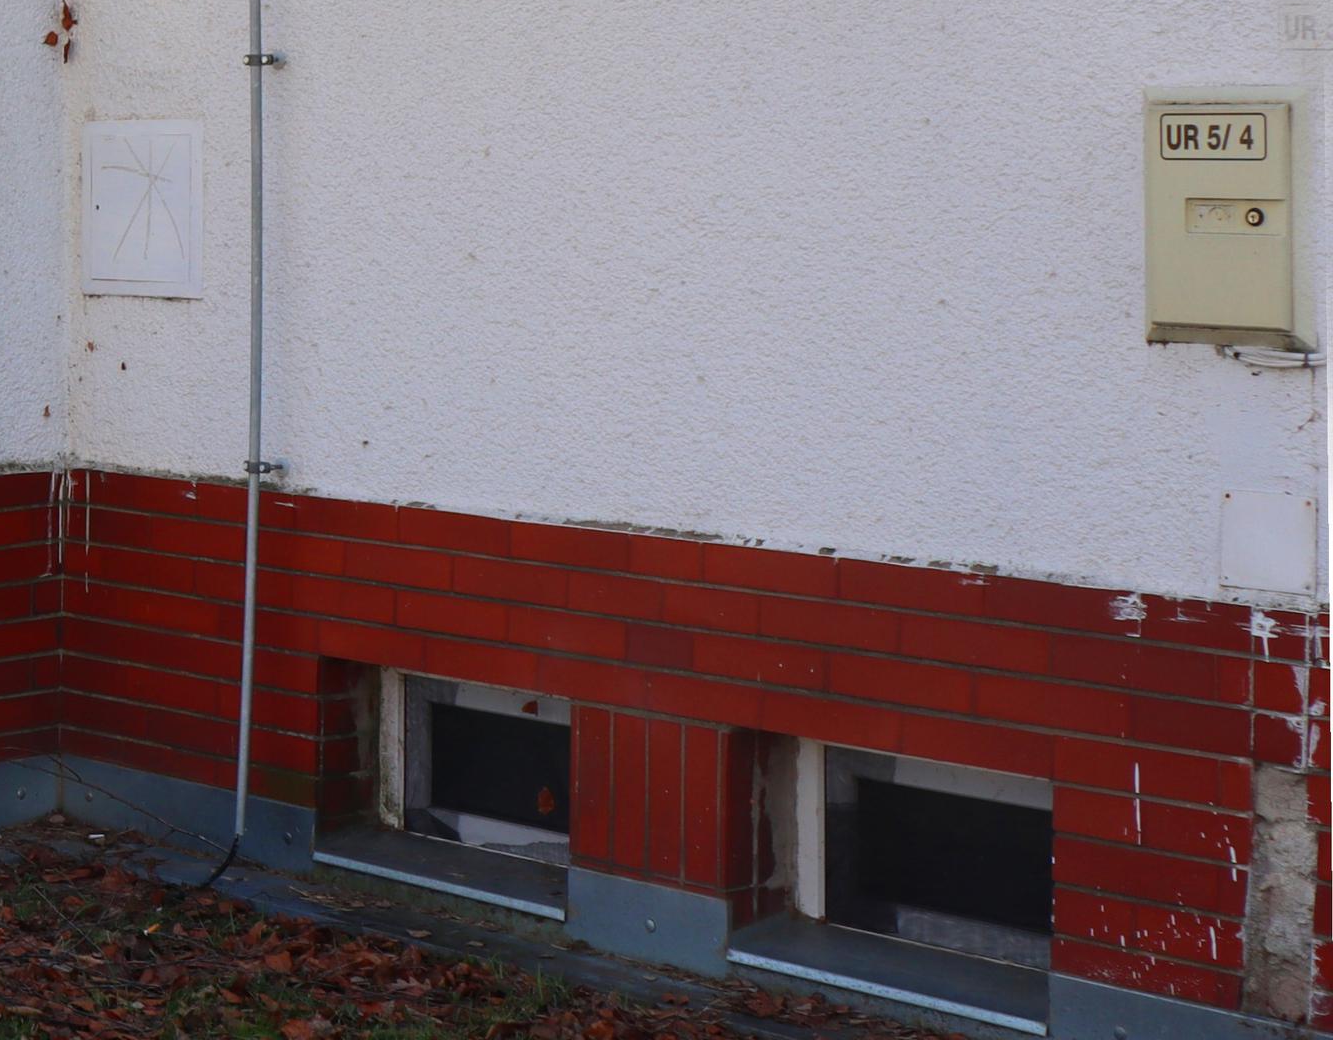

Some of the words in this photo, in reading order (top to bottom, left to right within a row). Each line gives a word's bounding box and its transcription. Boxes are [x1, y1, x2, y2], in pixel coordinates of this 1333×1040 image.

[1166, 124, 1199, 150] UR
[1207, 123, 1232, 151] 5/
[1239, 124, 1254, 150] 4
